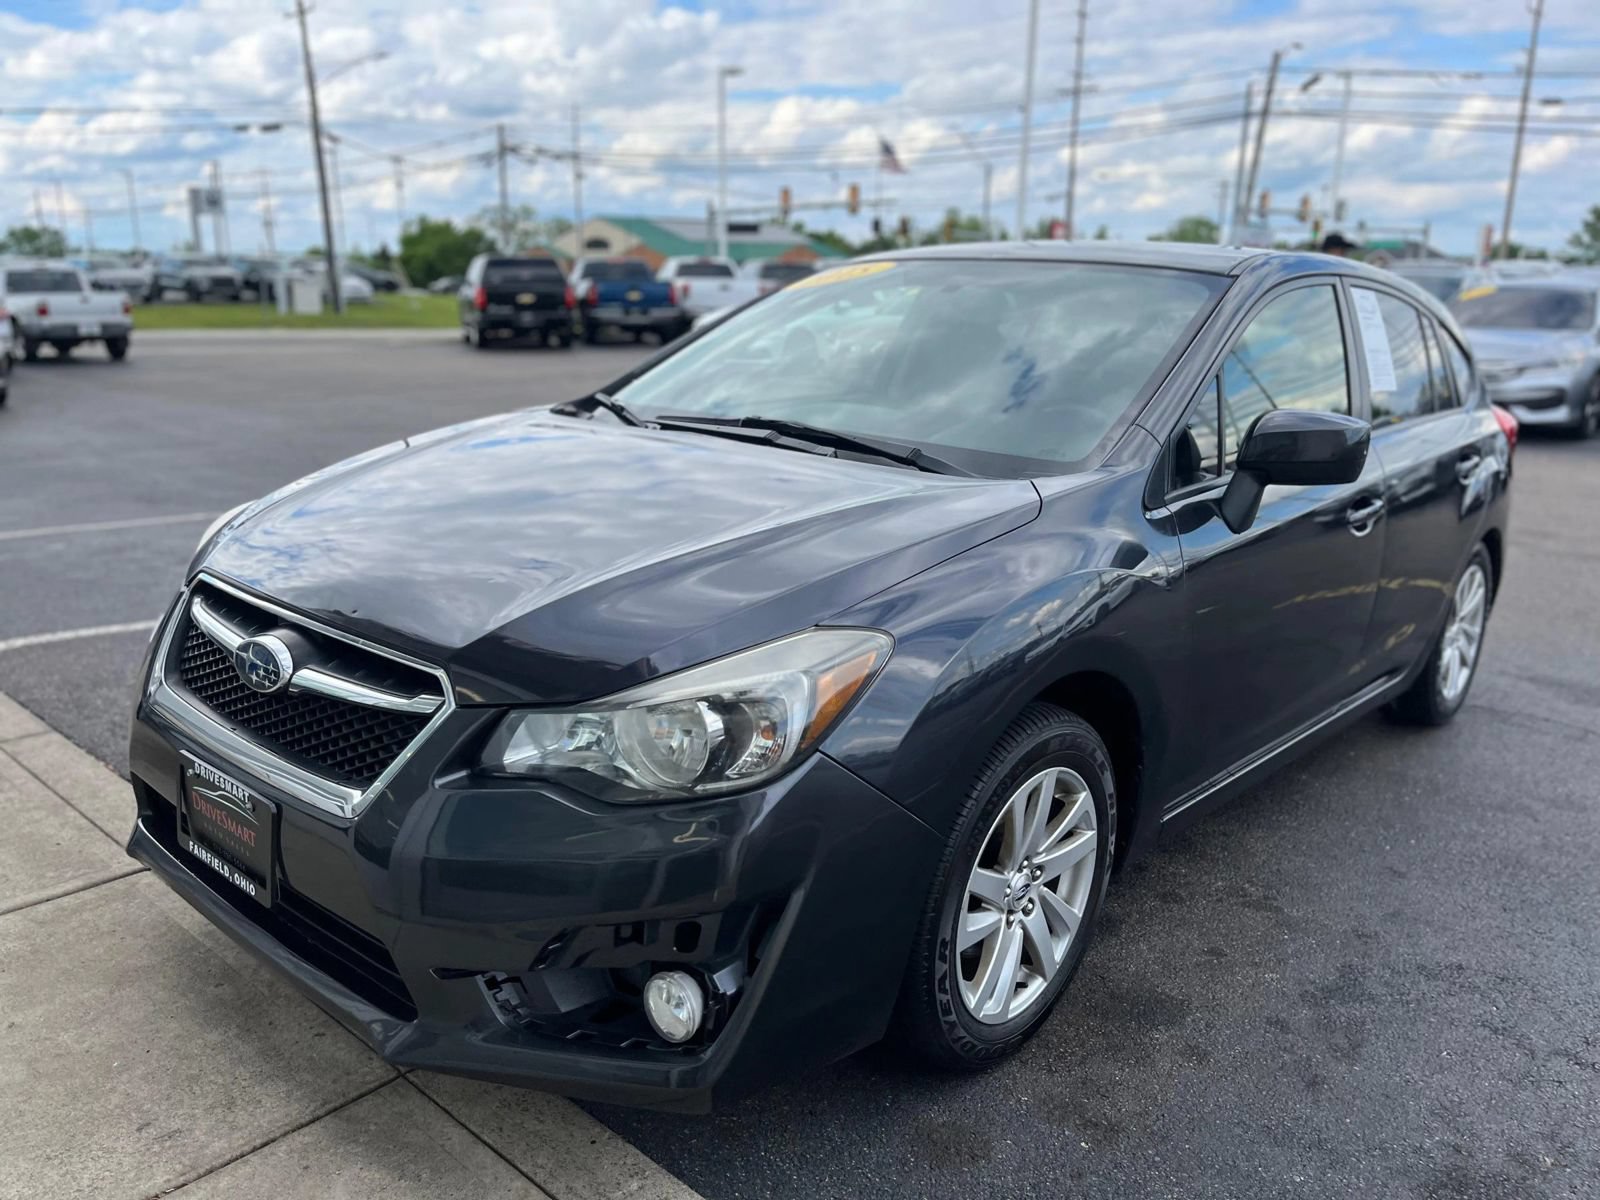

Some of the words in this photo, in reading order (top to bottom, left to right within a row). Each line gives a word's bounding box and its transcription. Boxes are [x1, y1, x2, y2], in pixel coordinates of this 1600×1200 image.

[194, 763, 250, 804] DRIVESMART
[189, 841, 233, 882] FAIRFIELD,
[233, 874, 256, 896] OHIO
